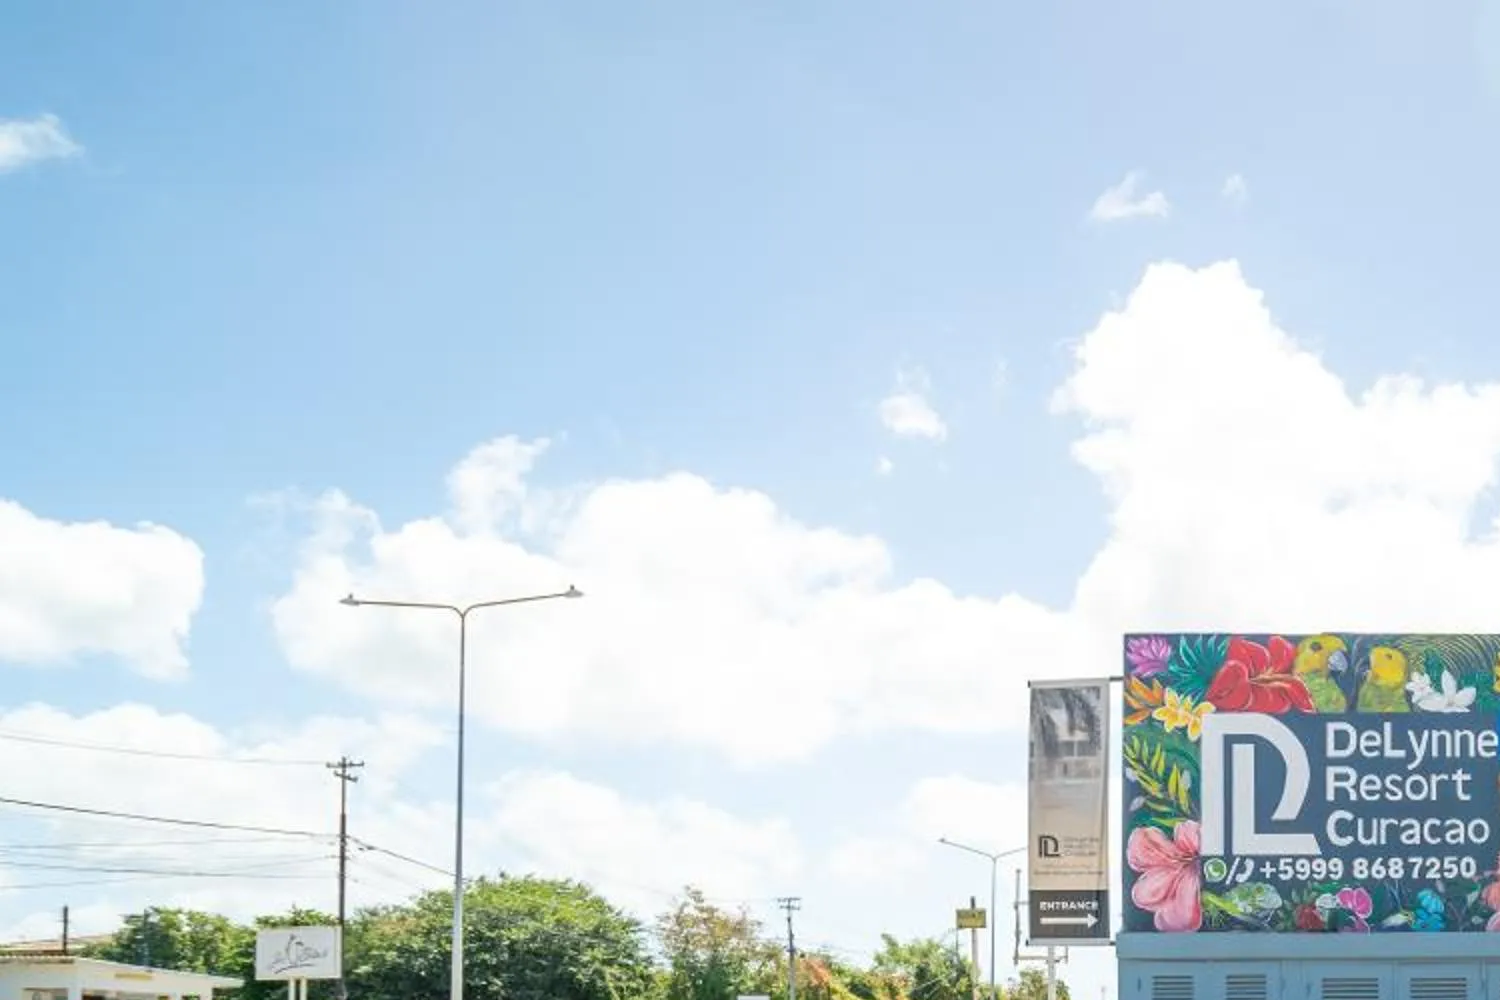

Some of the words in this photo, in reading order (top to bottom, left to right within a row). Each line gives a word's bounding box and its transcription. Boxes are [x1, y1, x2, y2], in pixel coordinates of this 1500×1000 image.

[1325, 721, 1499, 770] DeLynne
[1325, 765, 1473, 801] Resort
[1325, 809, 1491, 846] Curacao
[1259, 857, 1344, 881] +5999
[1039, 900, 1099, 911] ENTRANCE
